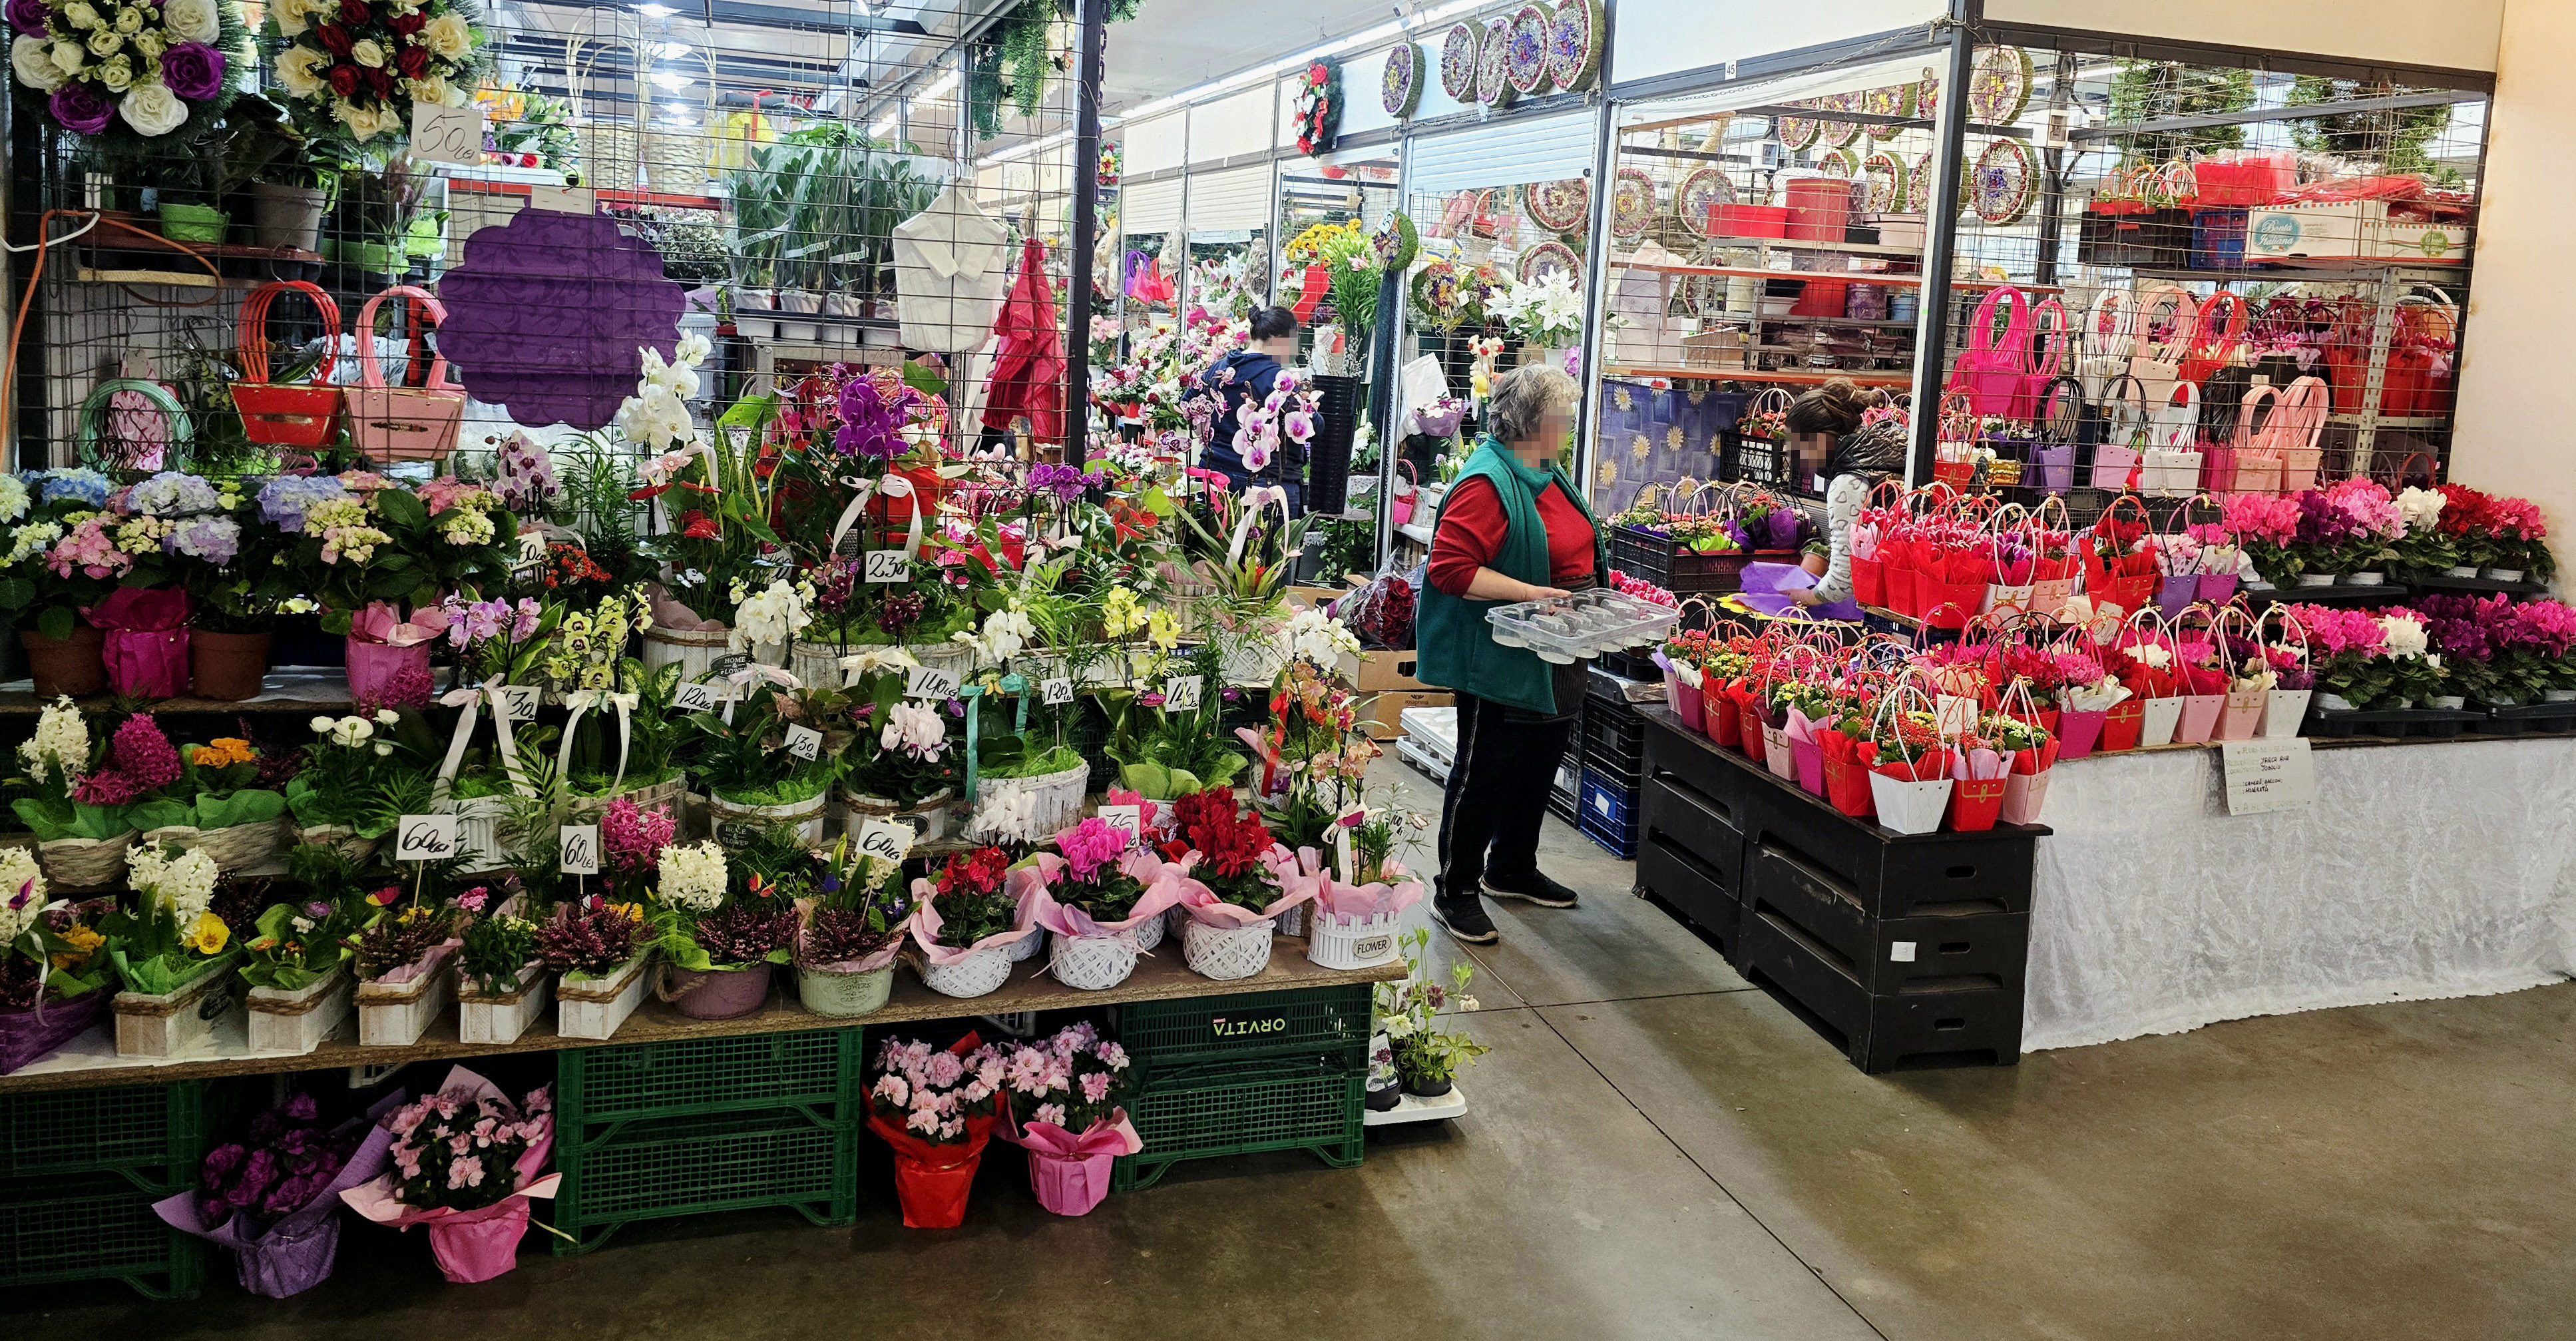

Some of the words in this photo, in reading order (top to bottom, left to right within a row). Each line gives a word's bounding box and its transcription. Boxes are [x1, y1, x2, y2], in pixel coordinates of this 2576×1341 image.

[1727, 65, 1735, 75] 45
[419, 114, 466, 152] 50
[2254, 233, 2294, 246] Italiana
[869, 553, 905, 578] 230
[402, 822, 439, 851] 60
[862, 831, 894, 852] 60
[564, 834, 587, 866] 60
[1357, 939, 1387, 954] FLOWER
[1213, 1018, 1286, 1036] ORVITA
